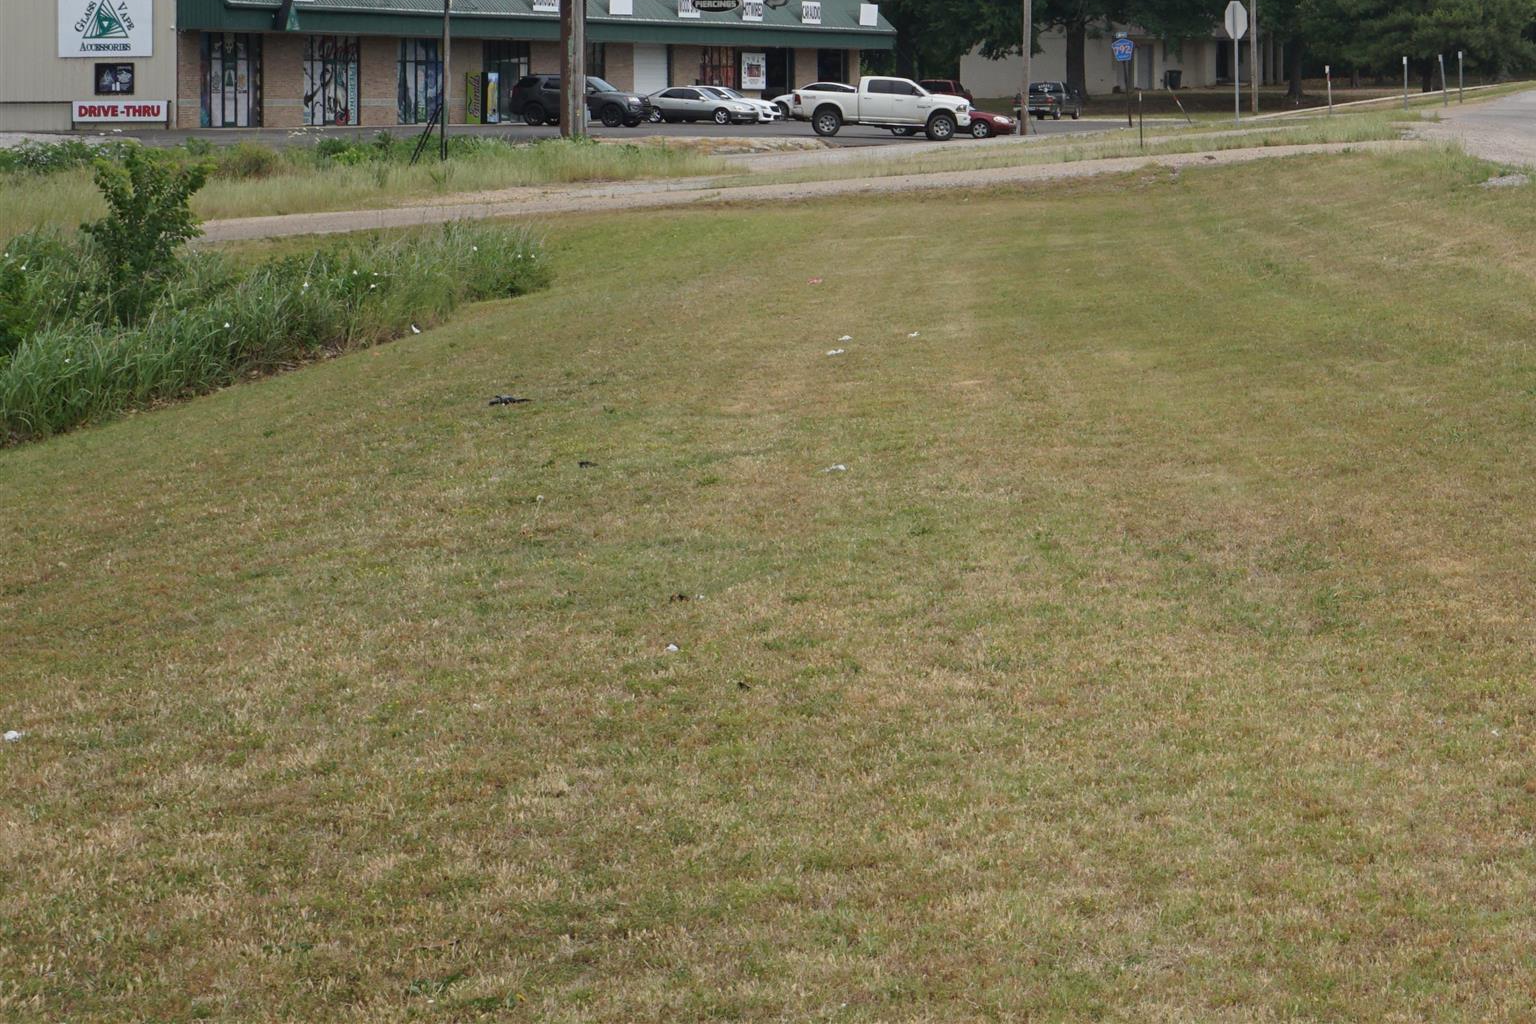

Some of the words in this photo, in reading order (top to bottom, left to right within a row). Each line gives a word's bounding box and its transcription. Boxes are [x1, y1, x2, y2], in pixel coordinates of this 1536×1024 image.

[694, 0, 737, 8] PIERCINGS
[74, 1, 97, 33] GLASS
[118, 1, 135, 31] VAPE
[80, 42, 131, 51] ACCESSORIES
